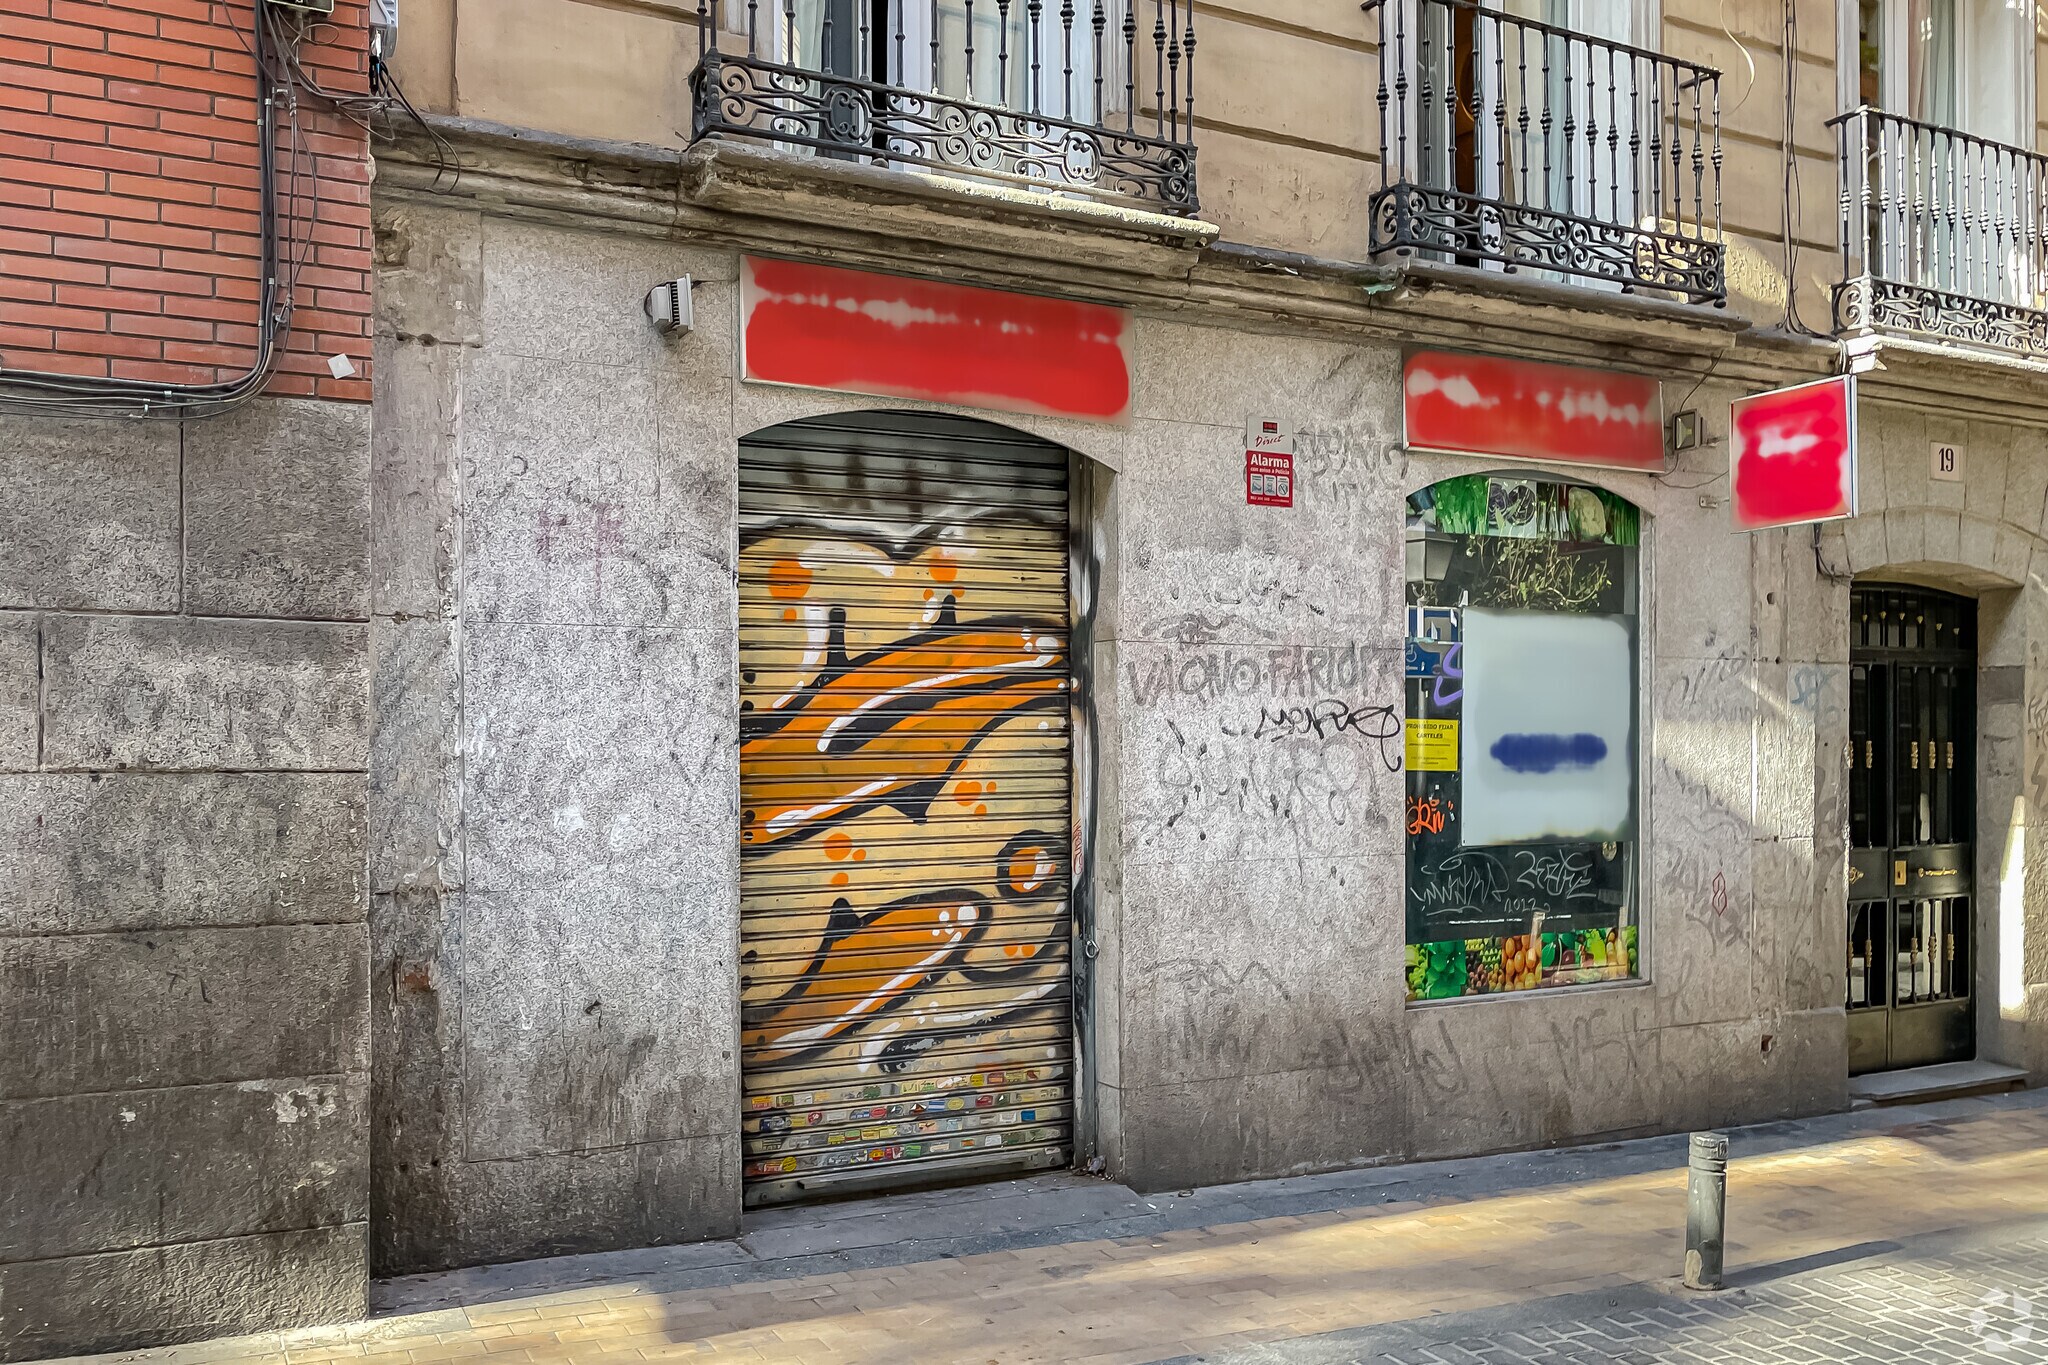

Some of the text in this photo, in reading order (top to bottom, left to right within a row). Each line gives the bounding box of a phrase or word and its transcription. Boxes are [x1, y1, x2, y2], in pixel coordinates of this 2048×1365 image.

[1255, 434, 1286, 447] Direct
[1251, 454, 1290, 468] Alarma
[1938, 447, 1954, 472] 19
